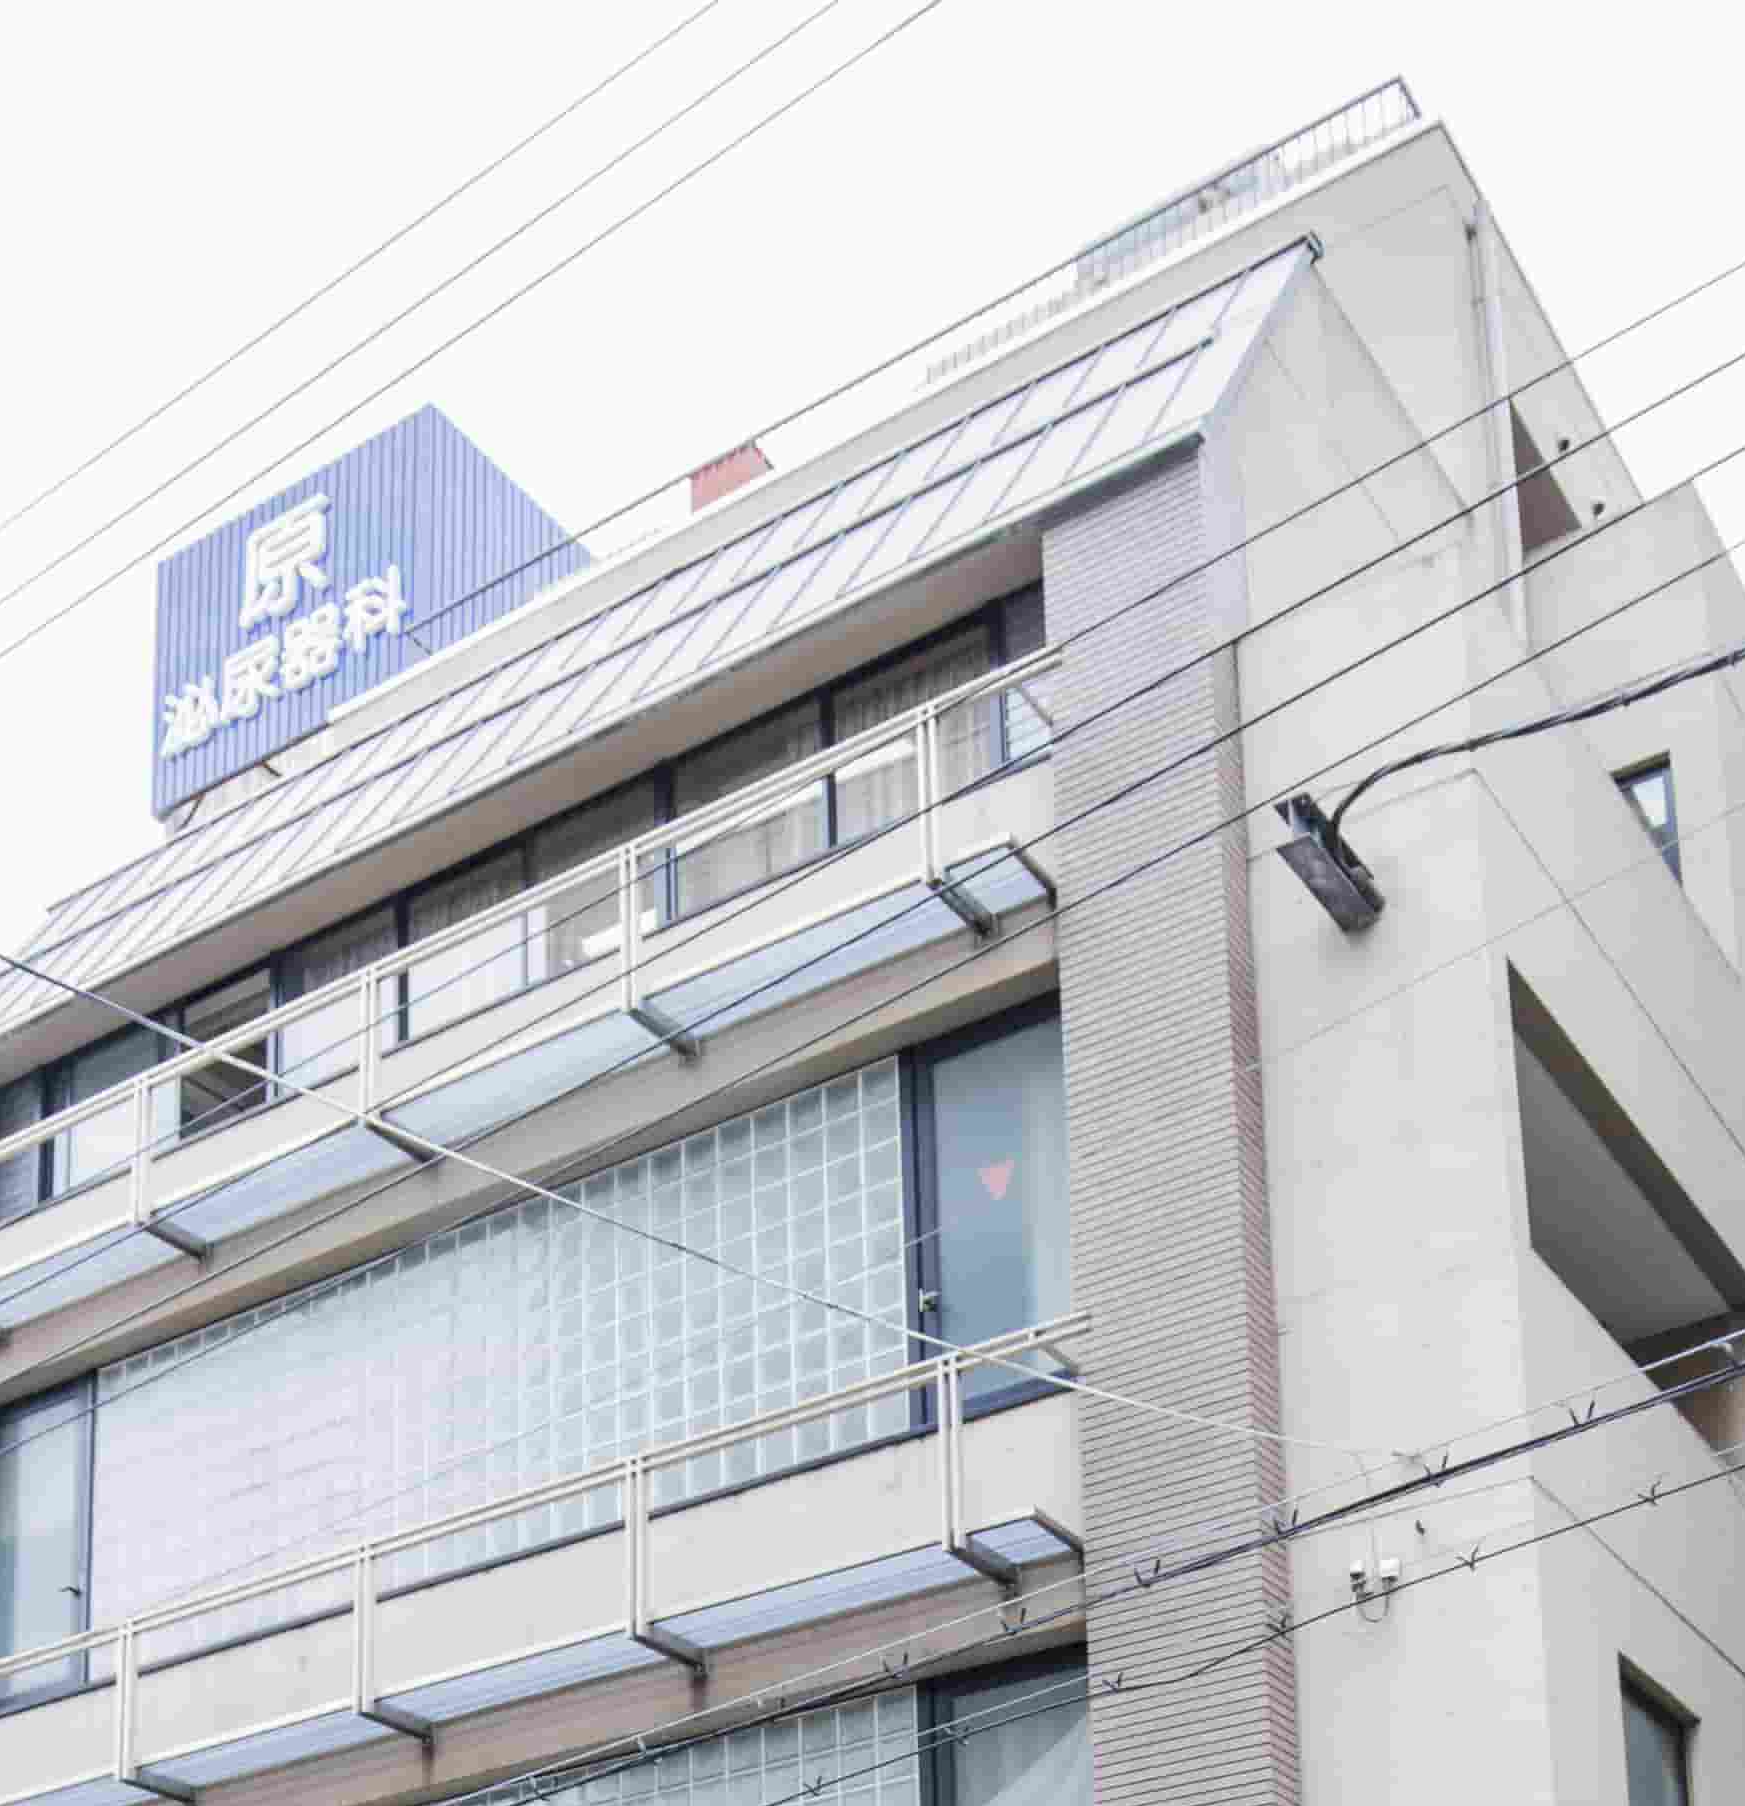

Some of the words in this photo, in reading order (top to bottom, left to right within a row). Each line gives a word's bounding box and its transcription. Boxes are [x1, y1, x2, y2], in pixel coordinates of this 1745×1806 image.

[238, 492, 332, 632] 原
[159, 562, 408, 761] 泌尿器科
